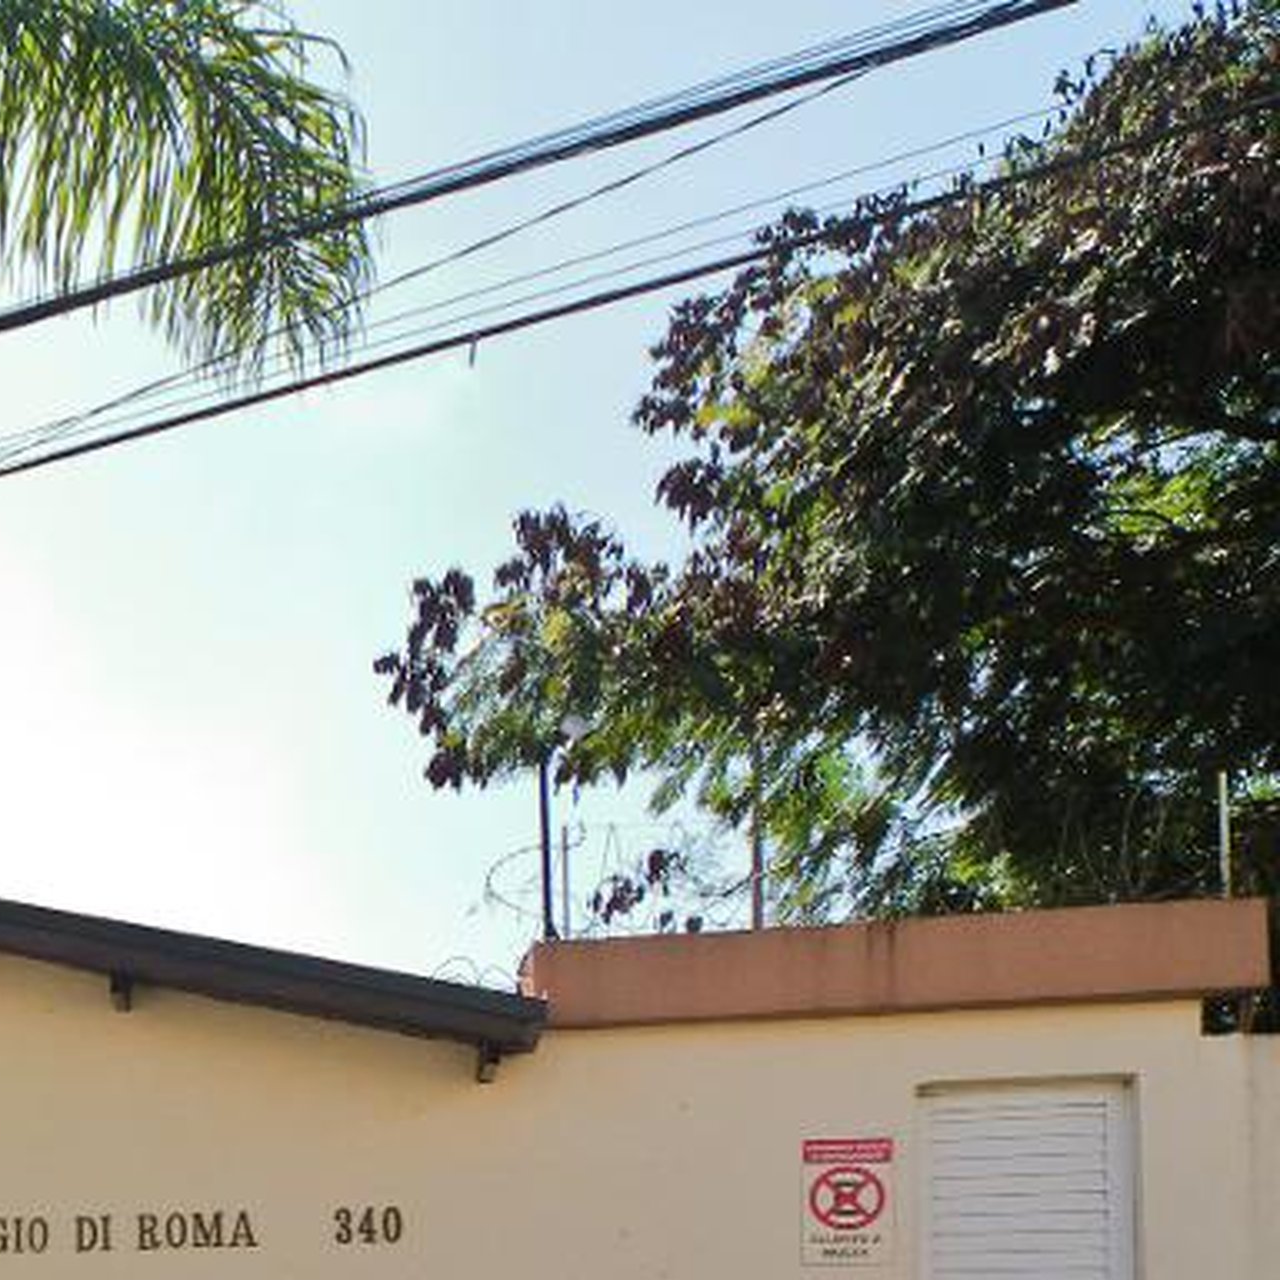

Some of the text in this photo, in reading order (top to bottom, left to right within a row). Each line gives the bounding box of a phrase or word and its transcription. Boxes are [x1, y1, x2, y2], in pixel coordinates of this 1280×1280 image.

[76, 1214, 112, 1253] DI
[138, 1211, 258, 1250] ROMA
[334, 1206, 402, 1244] 340
